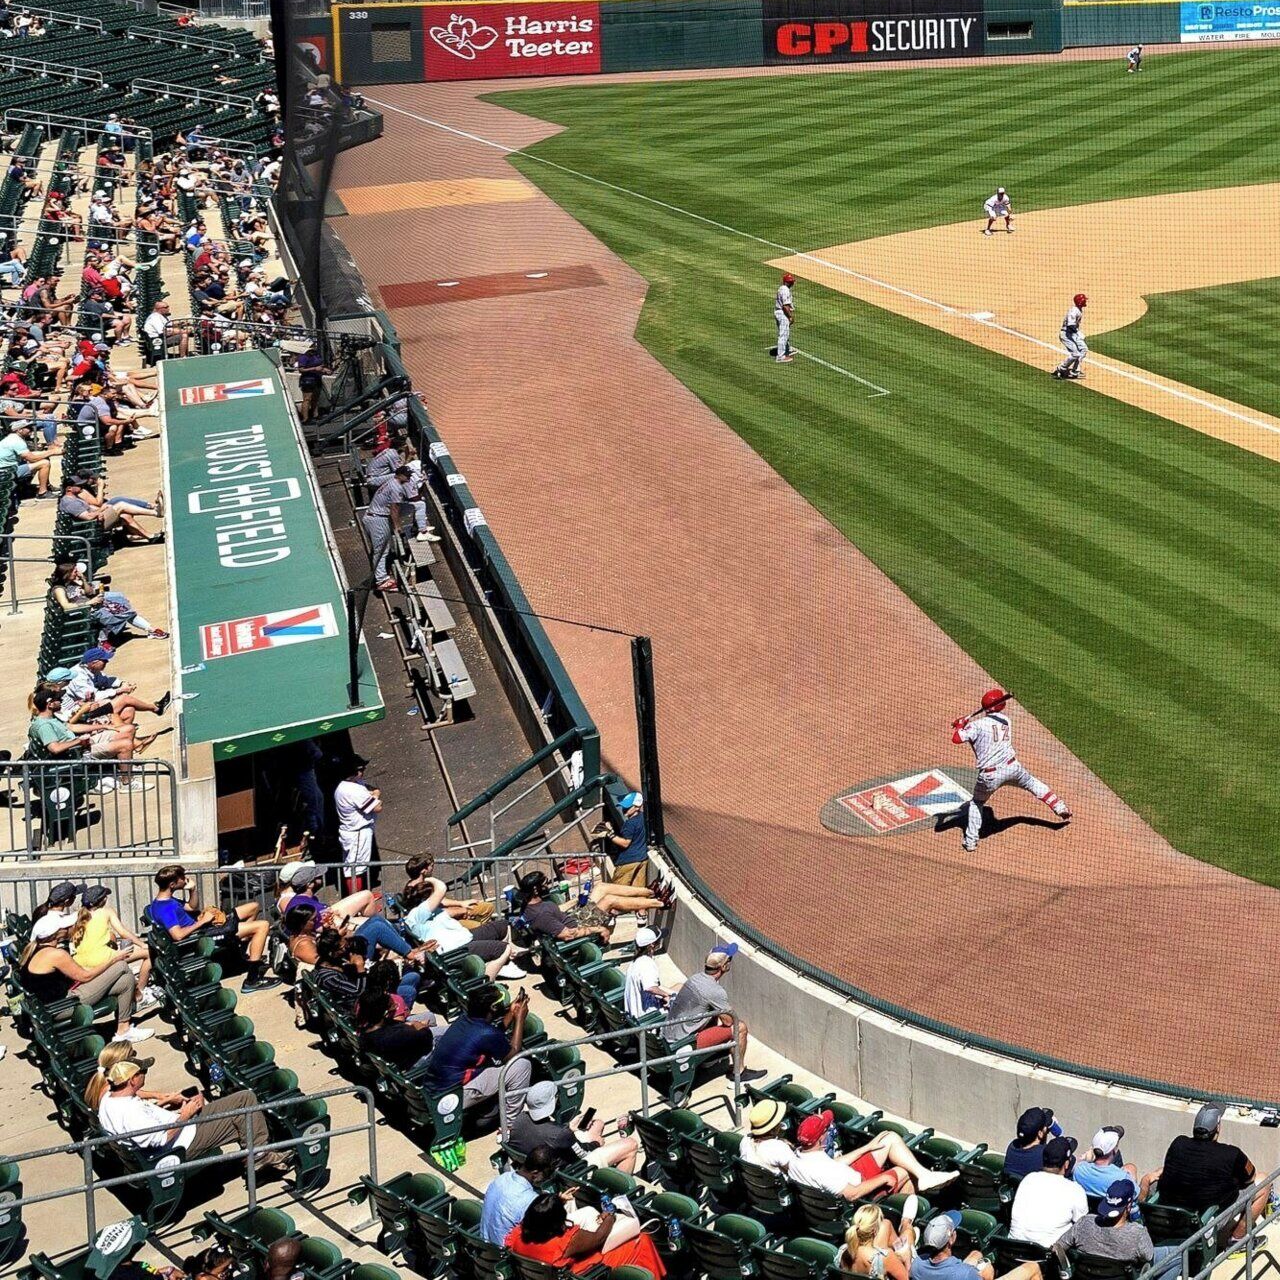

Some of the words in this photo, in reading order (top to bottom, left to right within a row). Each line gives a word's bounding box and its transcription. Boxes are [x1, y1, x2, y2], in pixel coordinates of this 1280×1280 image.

[349, 11, 368, 20] 330
[505, 15, 593, 36] Harris
[506, 38, 591, 58] Teeter
[776, 21, 868, 56] CPI
[871, 18, 973, 52] SECURITY
[204, 424, 273, 478] TRUIST
[214, 506, 291, 568] FIELD
